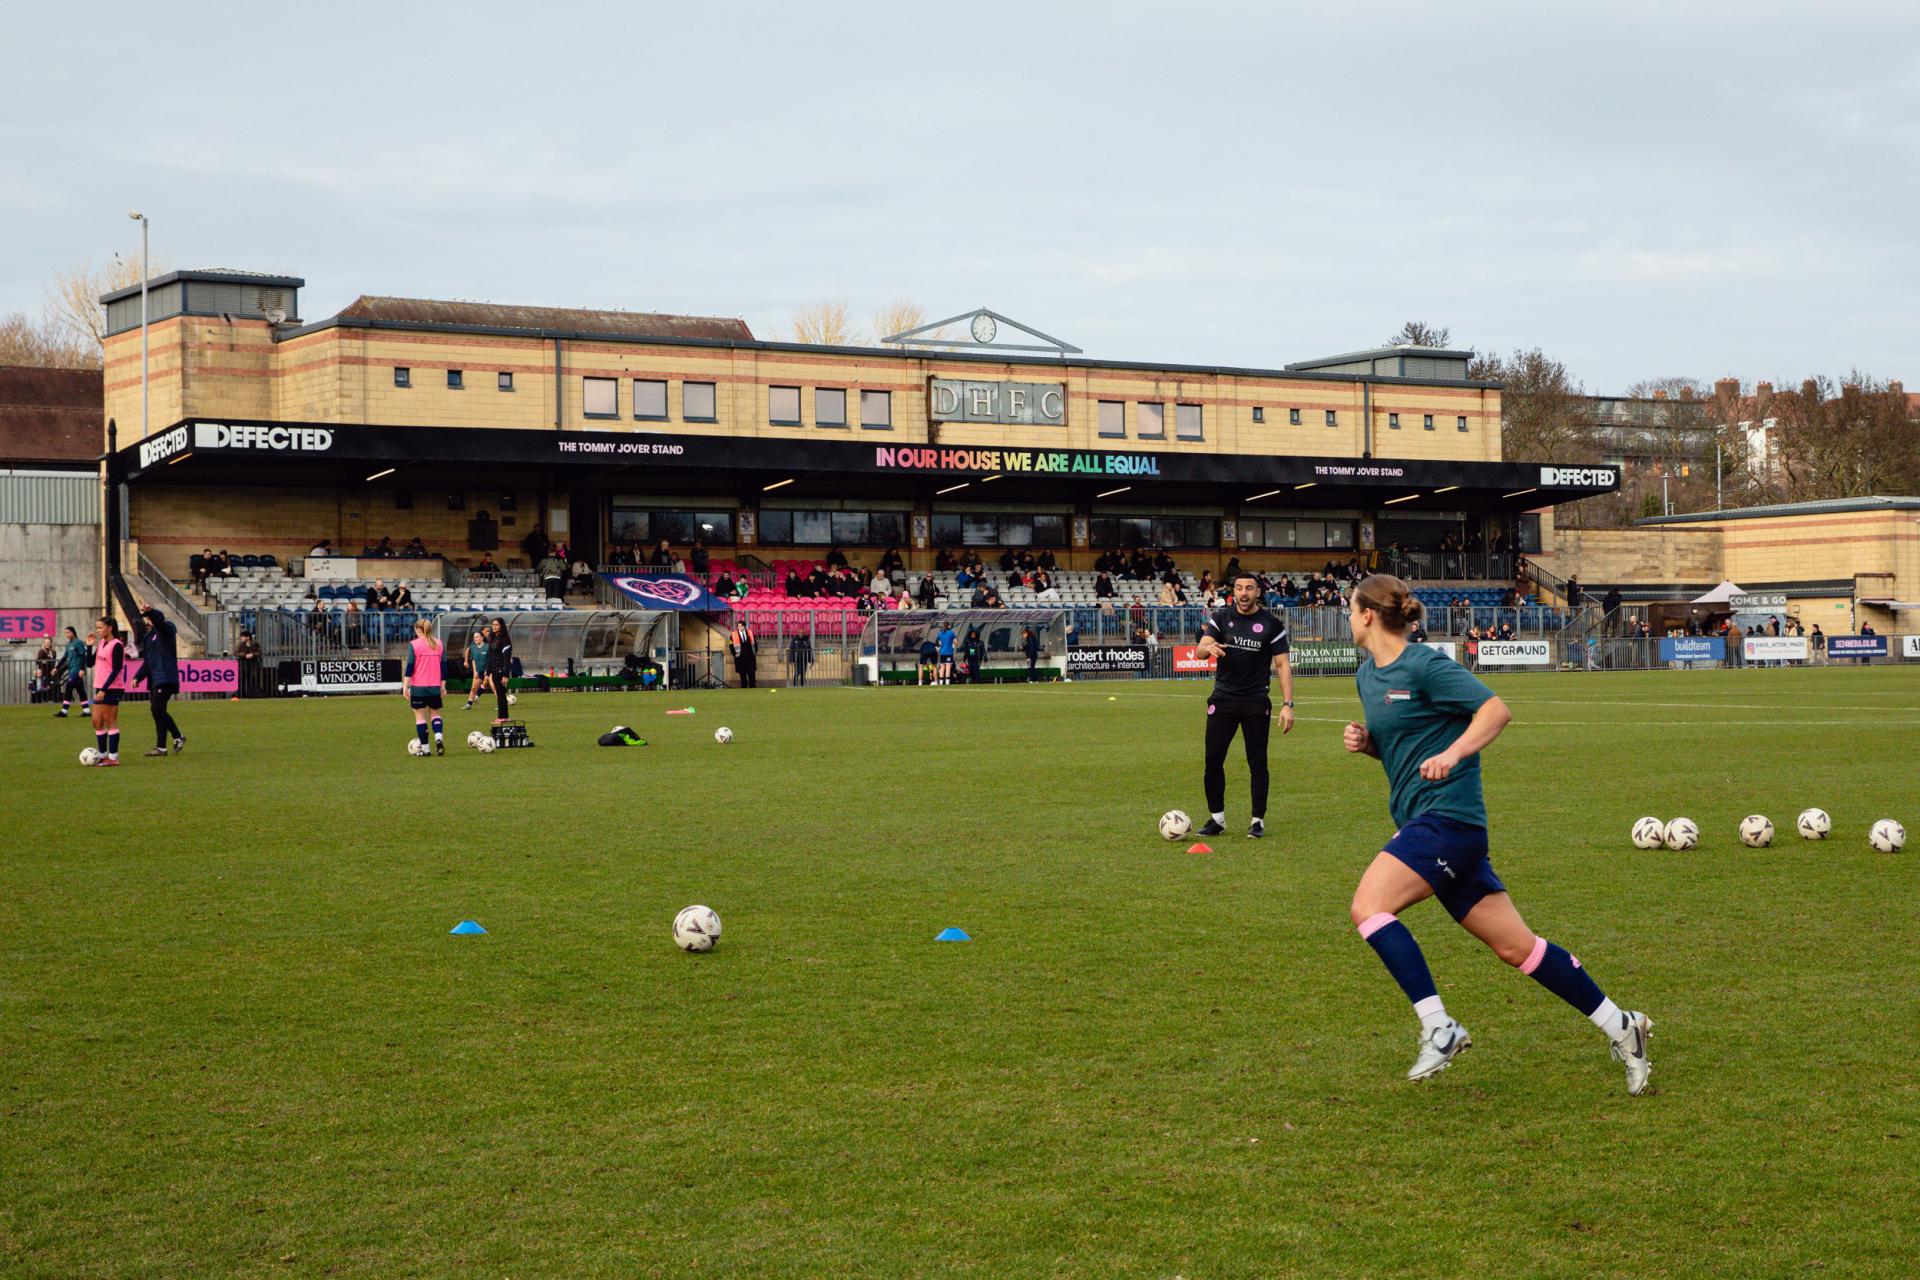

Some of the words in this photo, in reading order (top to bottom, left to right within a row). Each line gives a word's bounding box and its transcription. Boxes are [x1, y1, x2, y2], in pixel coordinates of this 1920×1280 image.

[195, 423, 333, 451] DEFECTED
[139, 426, 187, 468] DEFECTED
[559, 442, 577, 452] THE
[578, 442, 616, 453] TOMMY
[617, 444, 650, 454] JOVER
[652, 445, 684, 455] STAND
[876, 447, 896, 467] IN
[897, 448, 938, 468] OUR
[940, 450, 1001, 470] HOUSE
[1003, 452, 1032, 471] WE
[1034, 453, 1069, 472] ARE
[1072, 454, 1103, 473] ALL
[1105, 455, 1160, 475] EQUAL
[1315, 466, 1328, 475] THE
[1329, 466, 1355, 475] TOMMY
[1356, 467, 1379, 476] JOVER
[1380, 468, 1403, 476] STAND
[1540, 467, 1615, 486] DEFECTED
[1729, 596, 1759, 605] COME
[1761, 596, 1769, 605] &
[1771, 596, 1787, 605] GO
[0, 616, 45, 632] ETS
[1233, 635, 1262, 648] Virtus
[1674, 639, 1711, 651] buildteam
[1067, 648, 1103, 661] robert
[1106, 648, 1145, 661] rhodes
[1301, 648, 1319, 657] KICK
[1320, 648, 1330, 657] ON
[1331, 648, 1341, 657] AT
[1342, 647, 1357, 656] THE
[320, 661, 375, 672] BESPOKE
[1068, 661, 1110, 670] architecture
[1117, 661, 1145, 669] interiors
[1176, 659, 1209, 669] HOWDENS
[320, 673, 376, 683] WINDOWS
